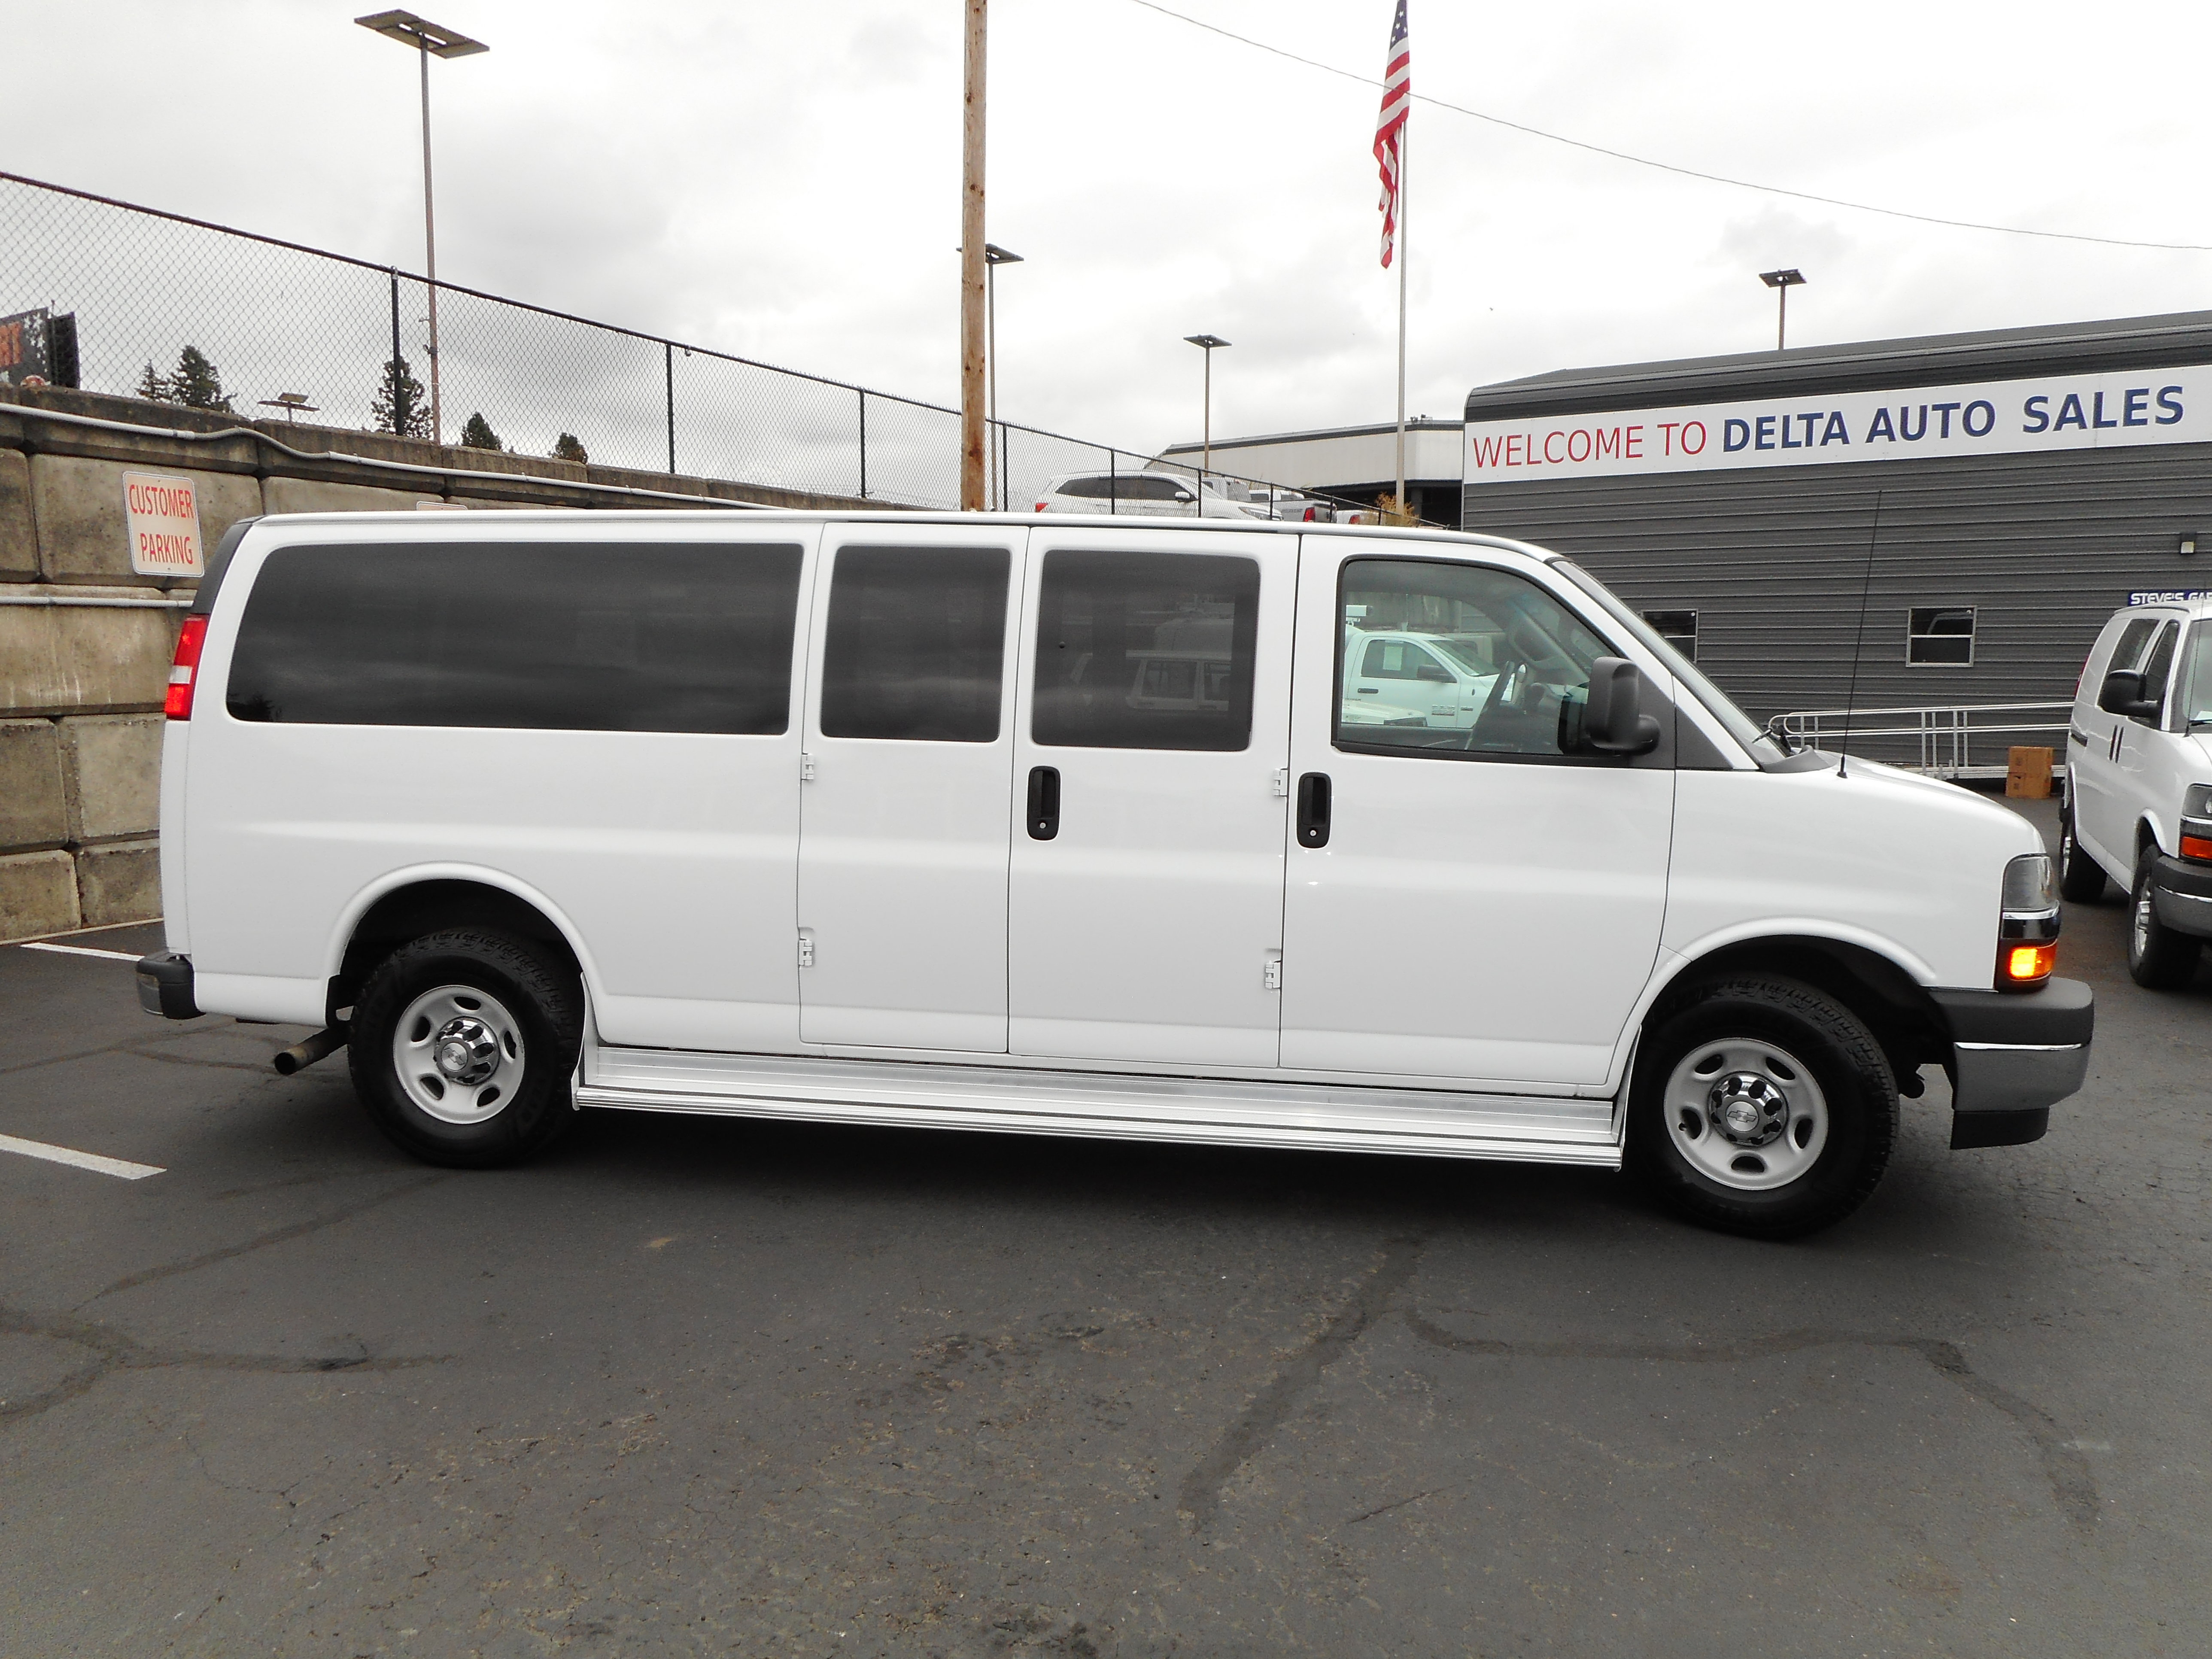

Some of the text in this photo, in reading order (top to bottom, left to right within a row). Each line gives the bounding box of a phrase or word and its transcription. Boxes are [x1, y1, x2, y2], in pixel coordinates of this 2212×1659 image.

[1473, 385, 2184, 468] WELCOME TO DELTA AUTO SALES
[129, 484, 194, 519] CUSTOMER
[140, 533, 193, 565] PARKING
[2130, 592, 2185, 605] STEVE'S
